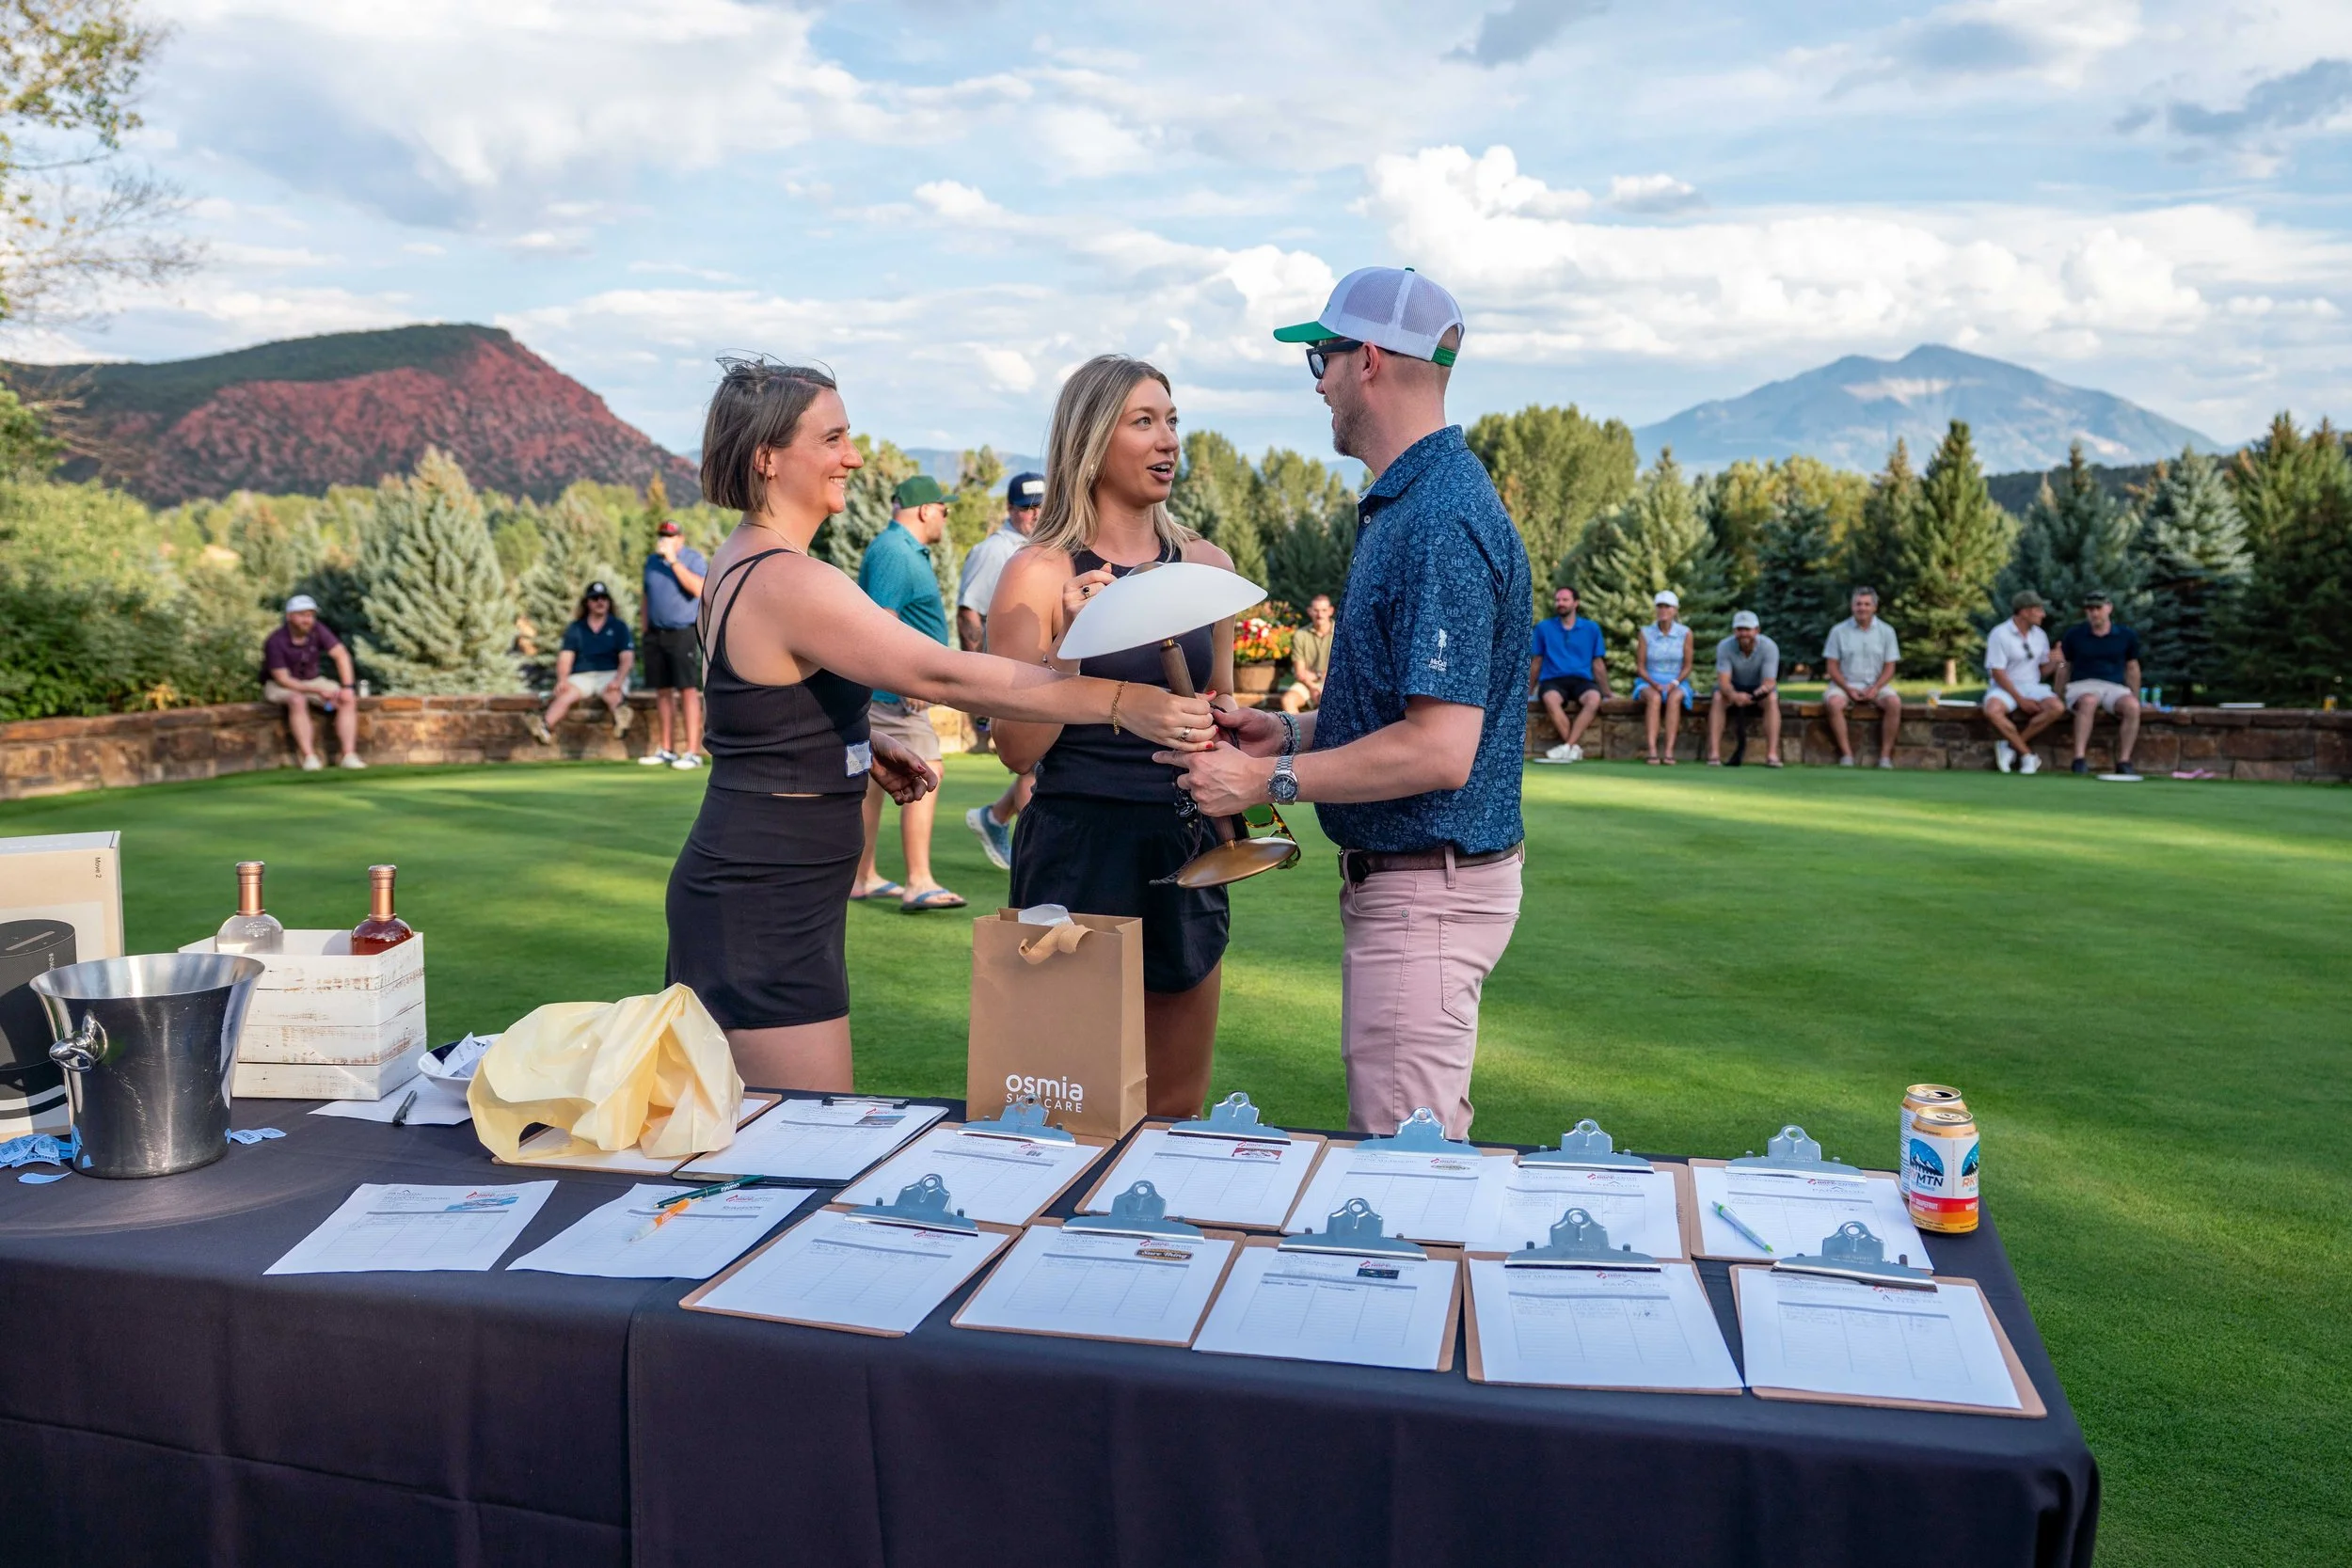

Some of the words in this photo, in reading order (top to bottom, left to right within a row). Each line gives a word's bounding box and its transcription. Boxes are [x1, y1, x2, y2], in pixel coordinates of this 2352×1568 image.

[1006, 1074, 1084, 1101] osmia
[1043, 1099, 1083, 1113] CARE
[1164, 1250, 1187, 1259] Thing
